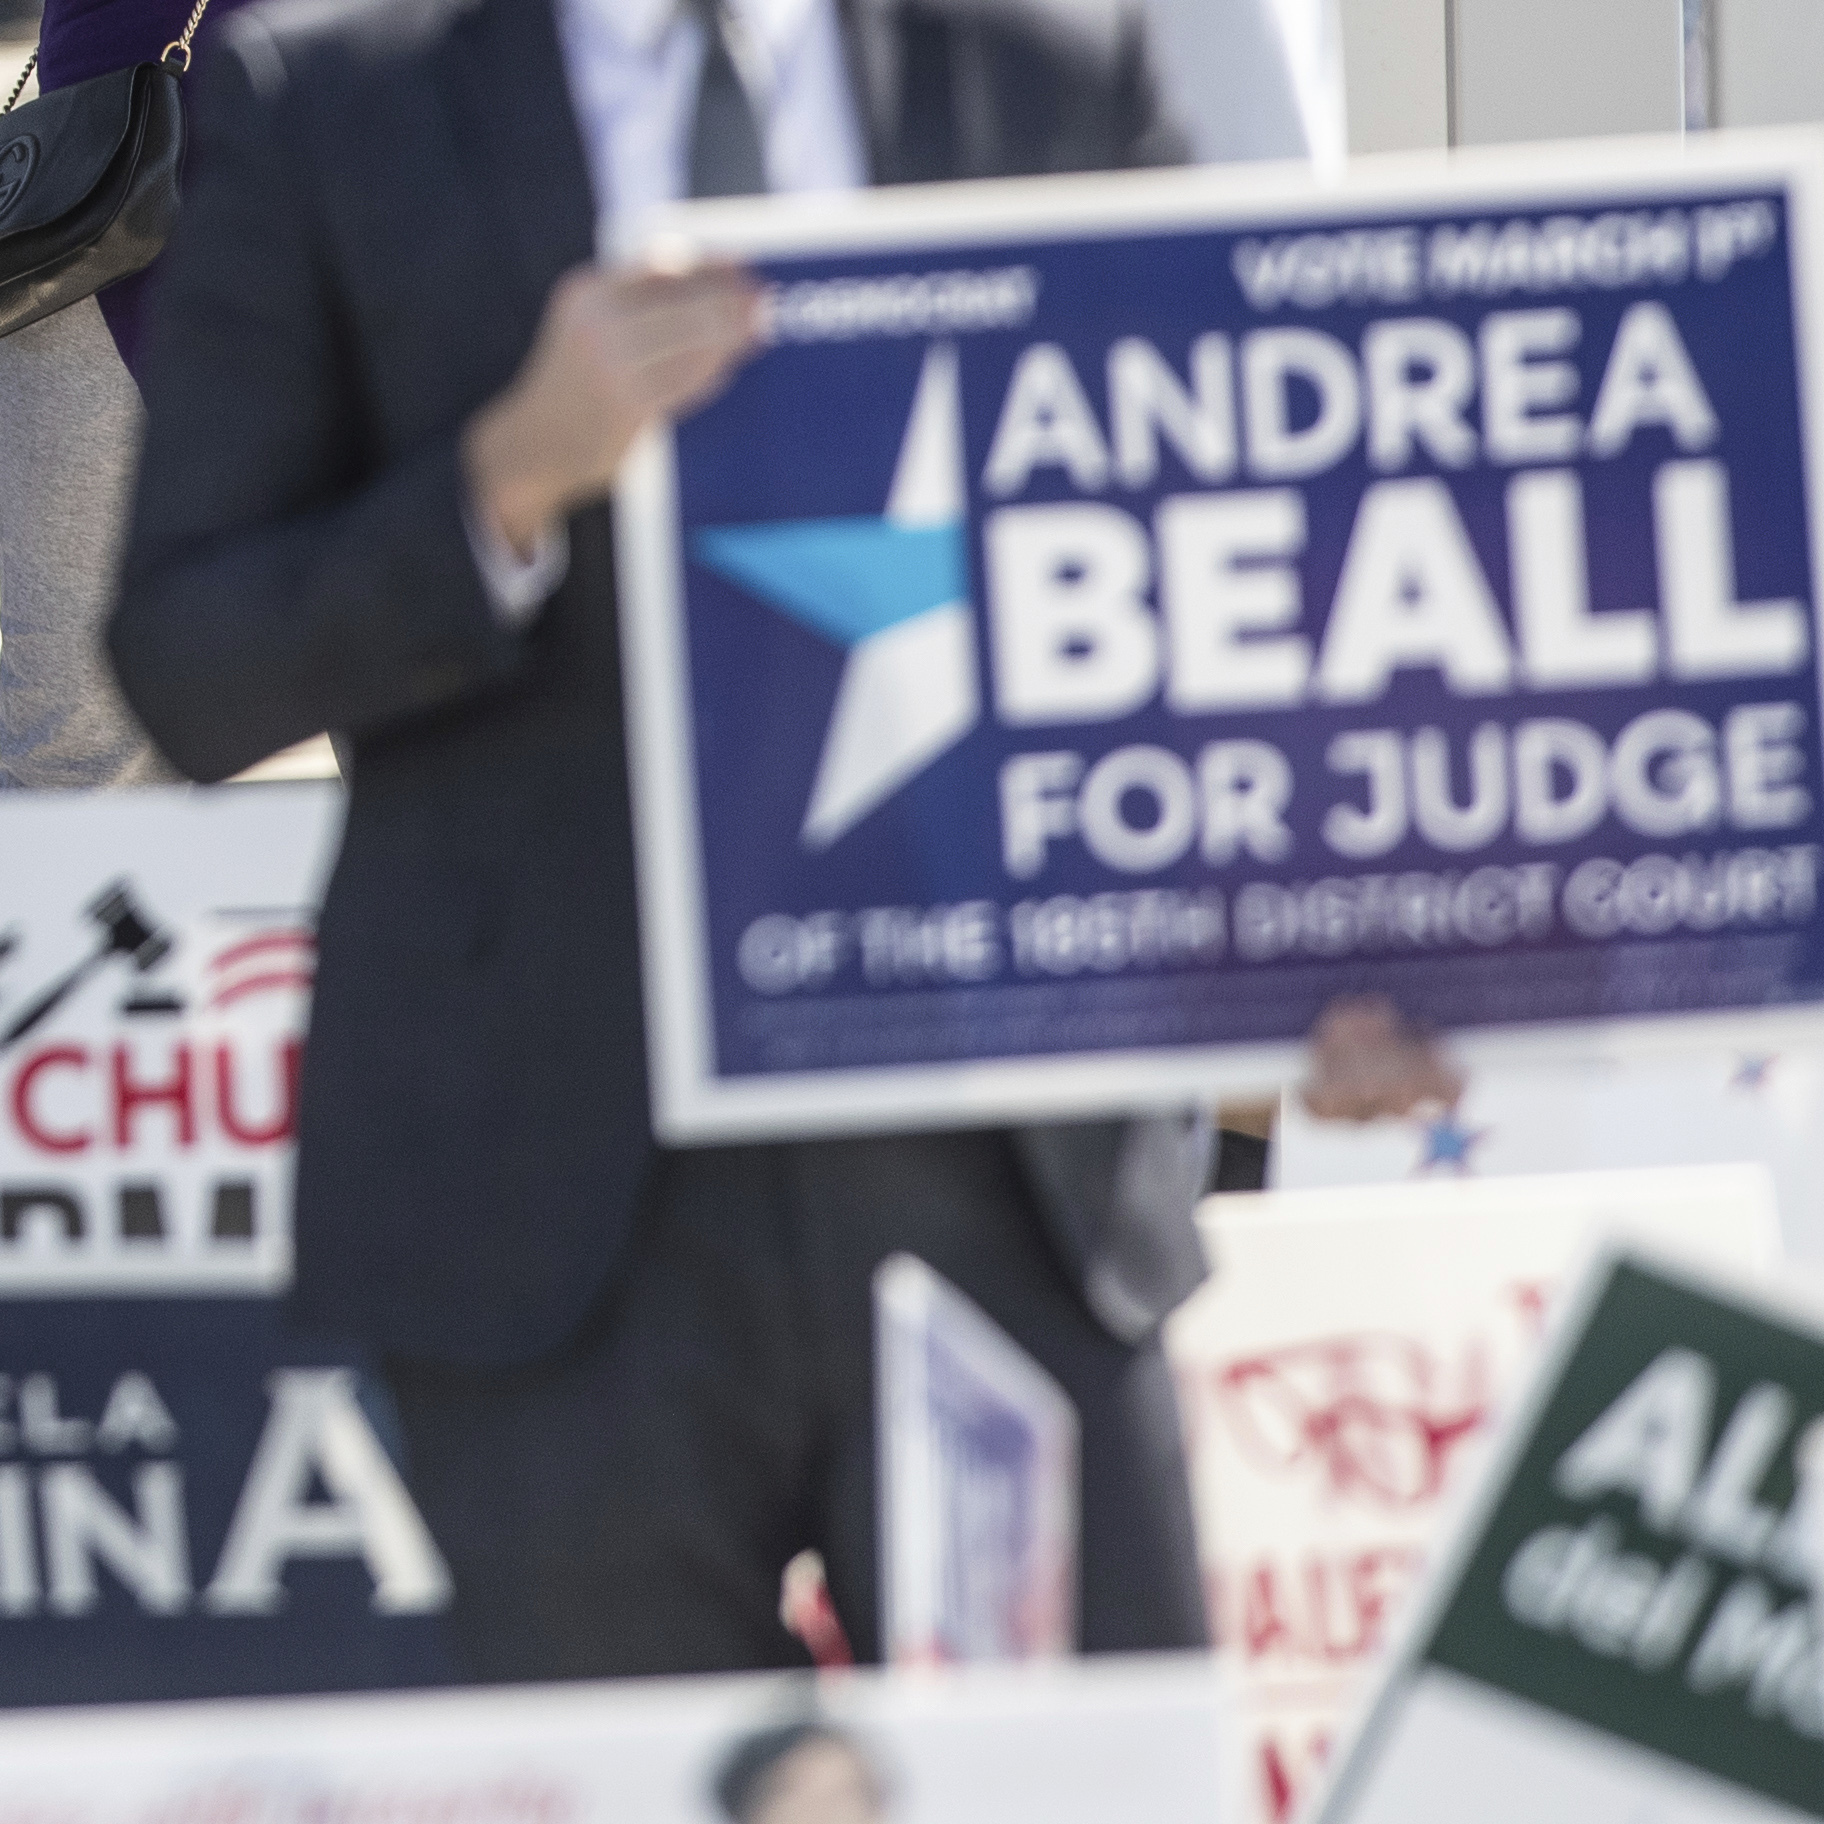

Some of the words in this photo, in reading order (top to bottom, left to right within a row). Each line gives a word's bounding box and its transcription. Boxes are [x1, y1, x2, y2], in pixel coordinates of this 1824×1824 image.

[1231, 221, 1428, 312] VOTE
[1430, 206, 1694, 298] MARCH
[981, 298, 1725, 496] ANDREA
[981, 456, 1812, 731] BEALL
[997, 736, 1298, 882] FOR
[1321, 699, 1818, 861] JUDGE
[1232, 859, 1558, 963] DISTRICT
[1562, 840, 1824, 942] COURT
[1501, 1514, 1718, 1673] del
